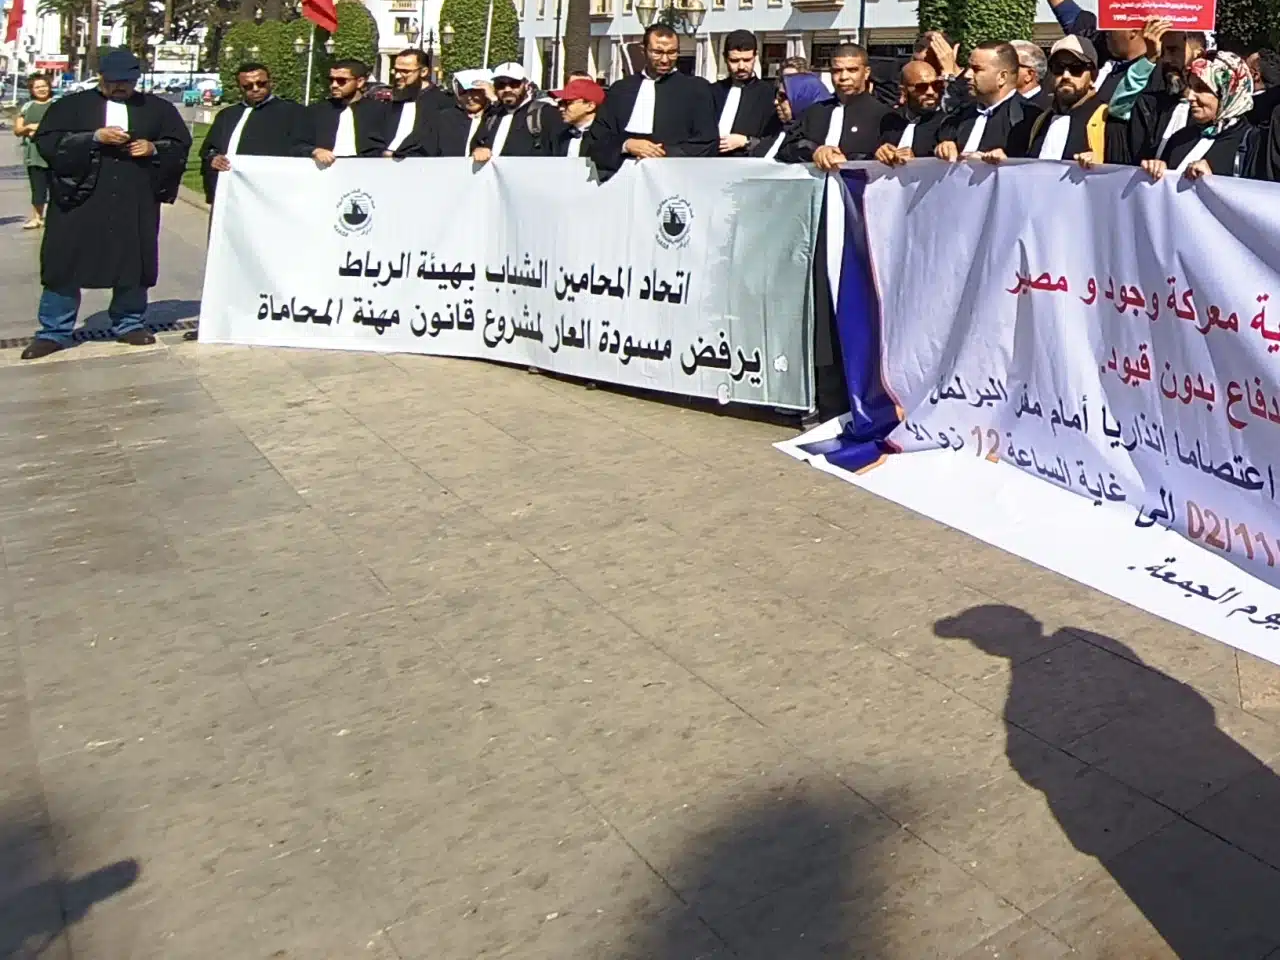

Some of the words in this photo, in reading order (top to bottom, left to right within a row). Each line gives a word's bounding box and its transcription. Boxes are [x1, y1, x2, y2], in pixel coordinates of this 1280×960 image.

[338, 251, 411, 287] الرباط
[417, 251, 476, 291] بهيئة
[485, 252, 548, 294] الشباب
[554, 262, 632, 302] المحامين
[639, 267, 692, 305] اتحاد
[257, 293, 343, 326] المحاماة
[1080, 277, 1096, 305] و
[1105, 276, 1160, 321] وجود
[1167, 276, 1239, 335] معركة
[352, 297, 400, 335] مهنة
[410, 298, 475, 337] قانون
[483, 305, 543, 348] لمشروع
[549, 314, 591, 353] العار
[599, 320, 672, 365] مسودة
[680, 328, 761, 384] يرفض
[1160, 361, 1216, 411] بدون
[1050, 394, 1088, 436] أمام
[971, 425, 1001, 463] 12
[1006, 431, 1072, 486] الساعة
[1174, 429, 1275, 500] اعتصاما
[1079, 460, 1126, 506] غاية
[1134, 487, 1175, 530] إلى
